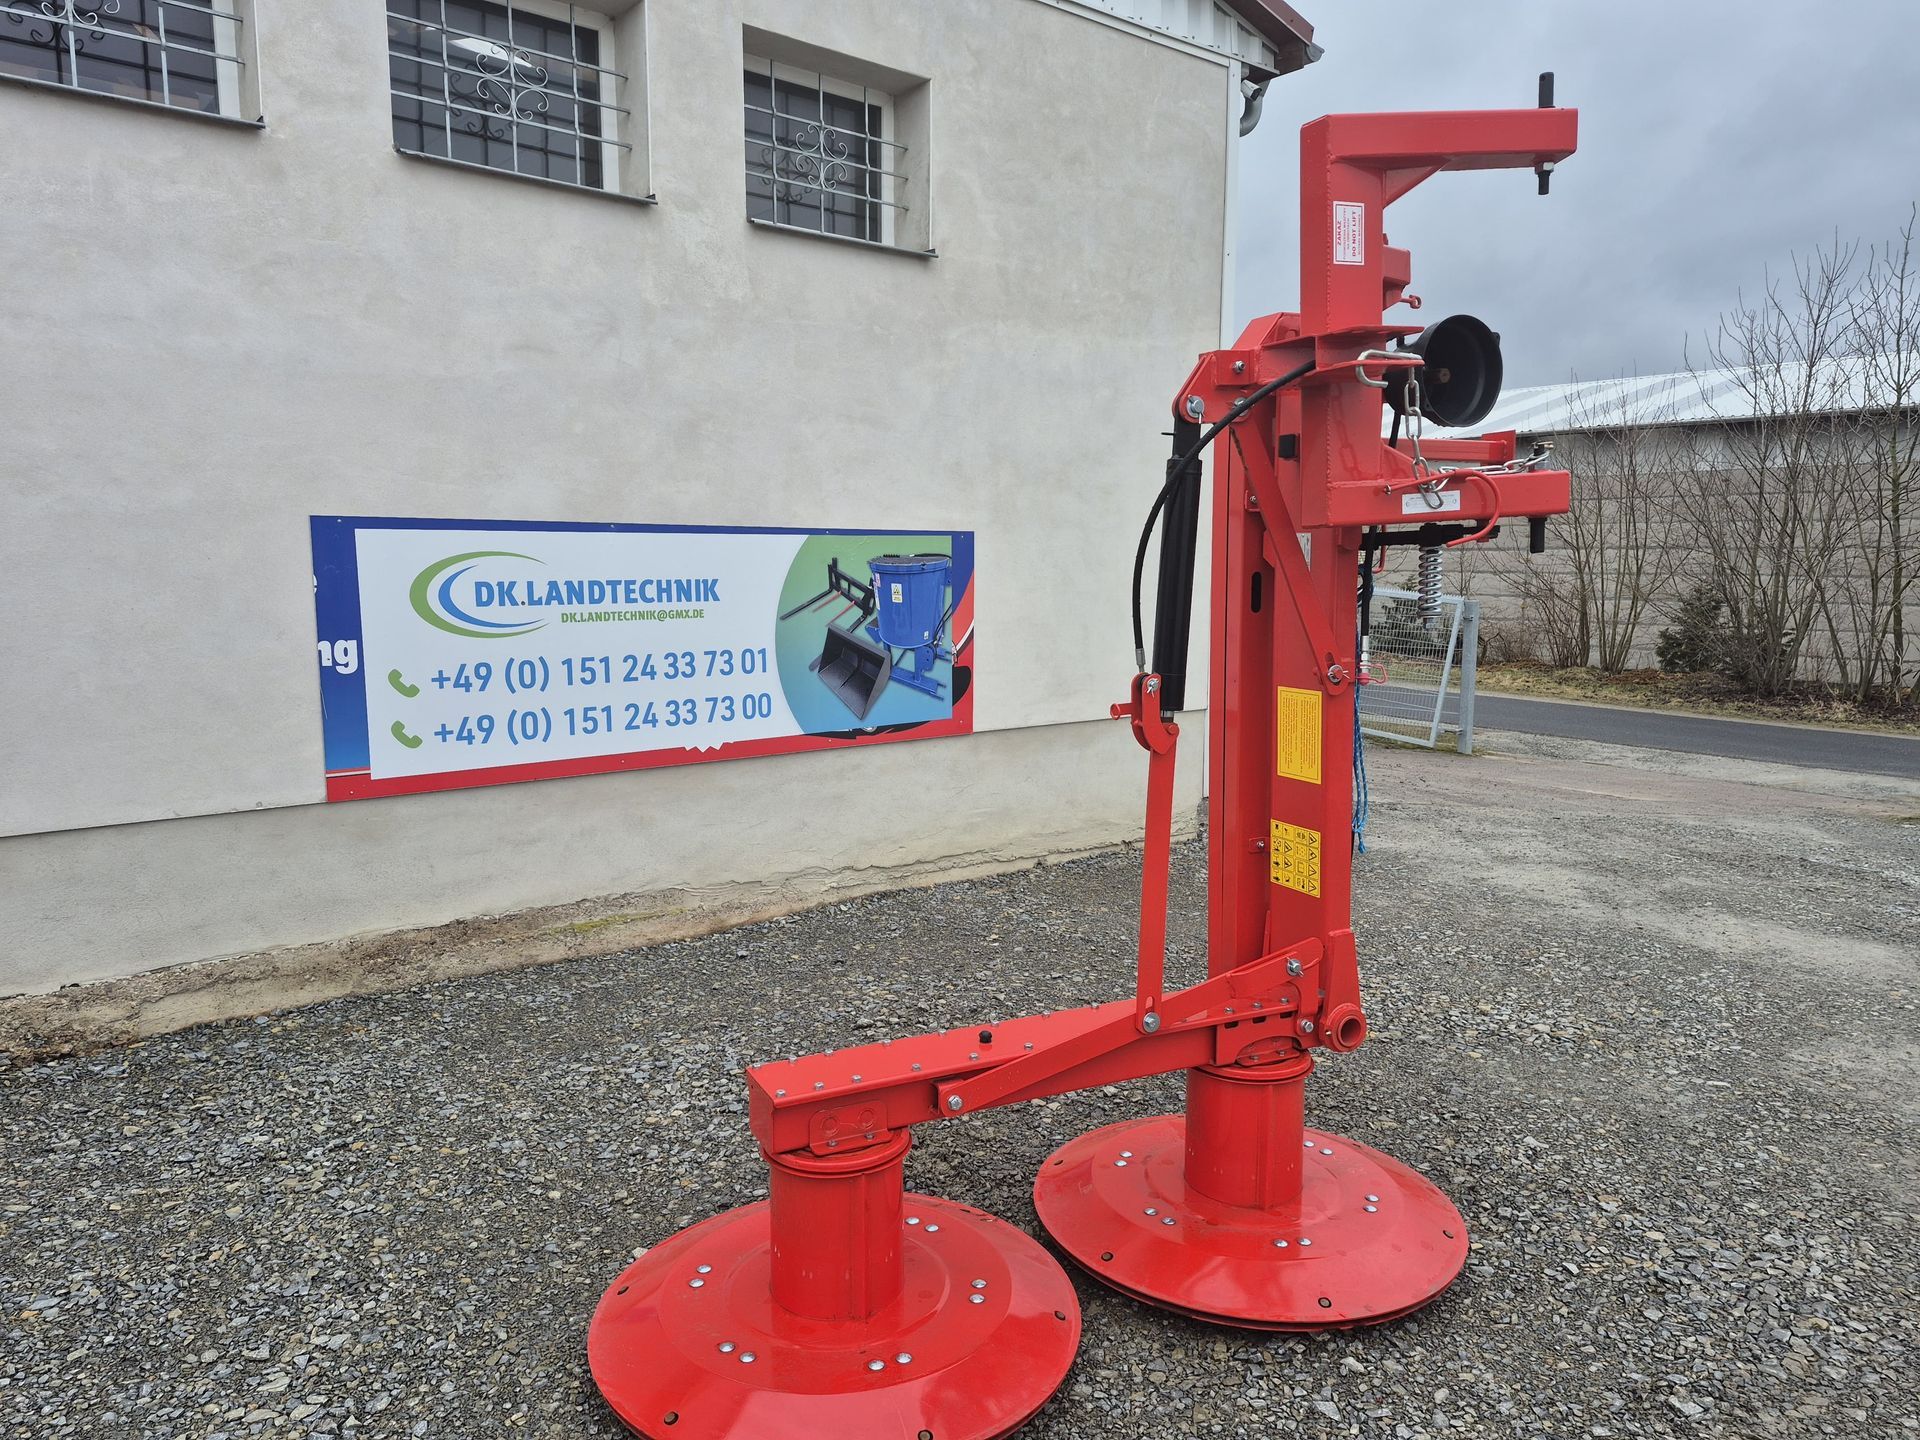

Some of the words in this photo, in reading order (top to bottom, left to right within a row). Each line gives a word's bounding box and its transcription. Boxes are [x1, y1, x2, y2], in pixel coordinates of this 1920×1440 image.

[1352, 246, 1357, 257] DO
[474, 578, 720, 607] DK.LANDTECHNIK
[561, 609, 704, 623] DK.LANDTECHNIK@GMX.DE
[431, 662, 492, 692] +49
[505, 656, 549, 694] (0)
[561, 656, 611, 686] 151
[623, 653, 657, 682] 24
[663, 652, 696, 679] 33
[703, 649, 734, 677] 73
[741, 648, 766, 674] 01
[434, 714, 495, 745] +49
[507, 707, 552, 746] (0)
[563, 705, 612, 736] 151
[624, 702, 659, 731] 24
[665, 698, 698, 726] 33
[705, 695, 735, 723] 73
[742, 692, 772, 720] 00
